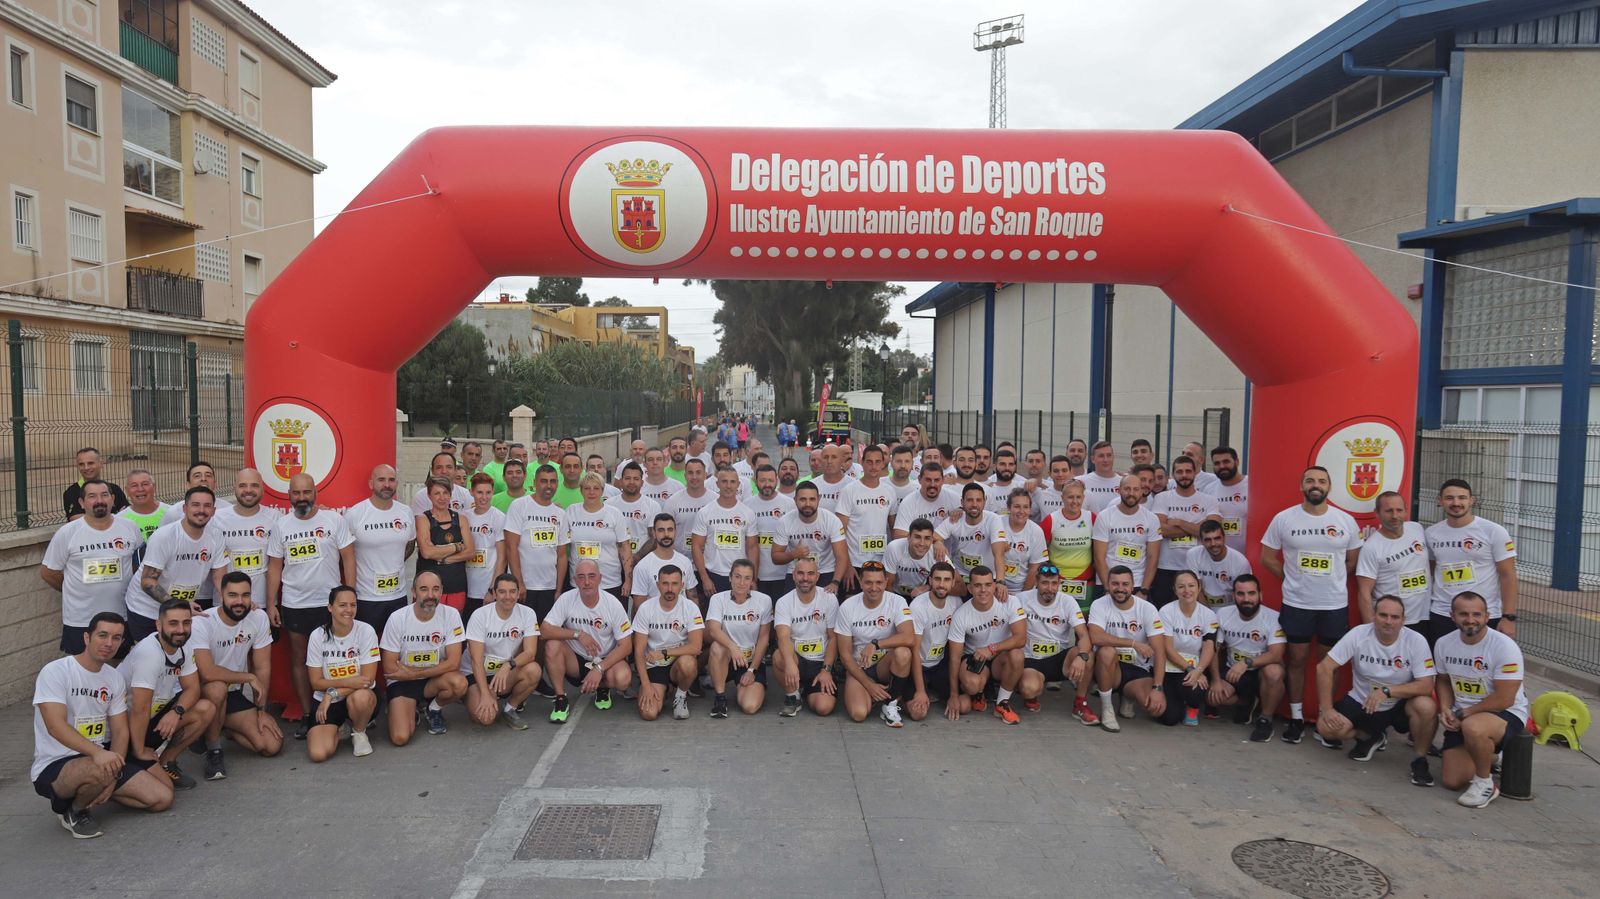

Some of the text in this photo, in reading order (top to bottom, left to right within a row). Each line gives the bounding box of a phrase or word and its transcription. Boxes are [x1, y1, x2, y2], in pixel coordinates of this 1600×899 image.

[731, 152, 1106, 199] Delegación de Deportes
[730, 203, 1104, 239] Ilustre Ayuntamiento de San Roque
[534, 532, 555, 541] 187
[717, 534, 739, 544] 142
[862, 540, 884, 549] 180
[289, 544, 317, 557] 348
[579, 547, 593, 555] 61
[1122, 547, 1137, 557] 56
[234, 556, 260, 566] 111
[960, 556, 980, 566] 152
[1301, 558, 1329, 569] 288
[88, 564, 118, 575] 275
[1446, 570, 1464, 580] 17
[377, 577, 399, 589] 243
[1402, 575, 1427, 588] 298
[1062, 585, 1083, 593] 379
[802, 644, 818, 652] 67
[1032, 644, 1056, 653] 241
[1117, 653, 1132, 661] 13
[487, 662, 503, 670] 34
[329, 665, 357, 678] 356
[1456, 680, 1481, 693] 197
[86, 723, 103, 735] 19
